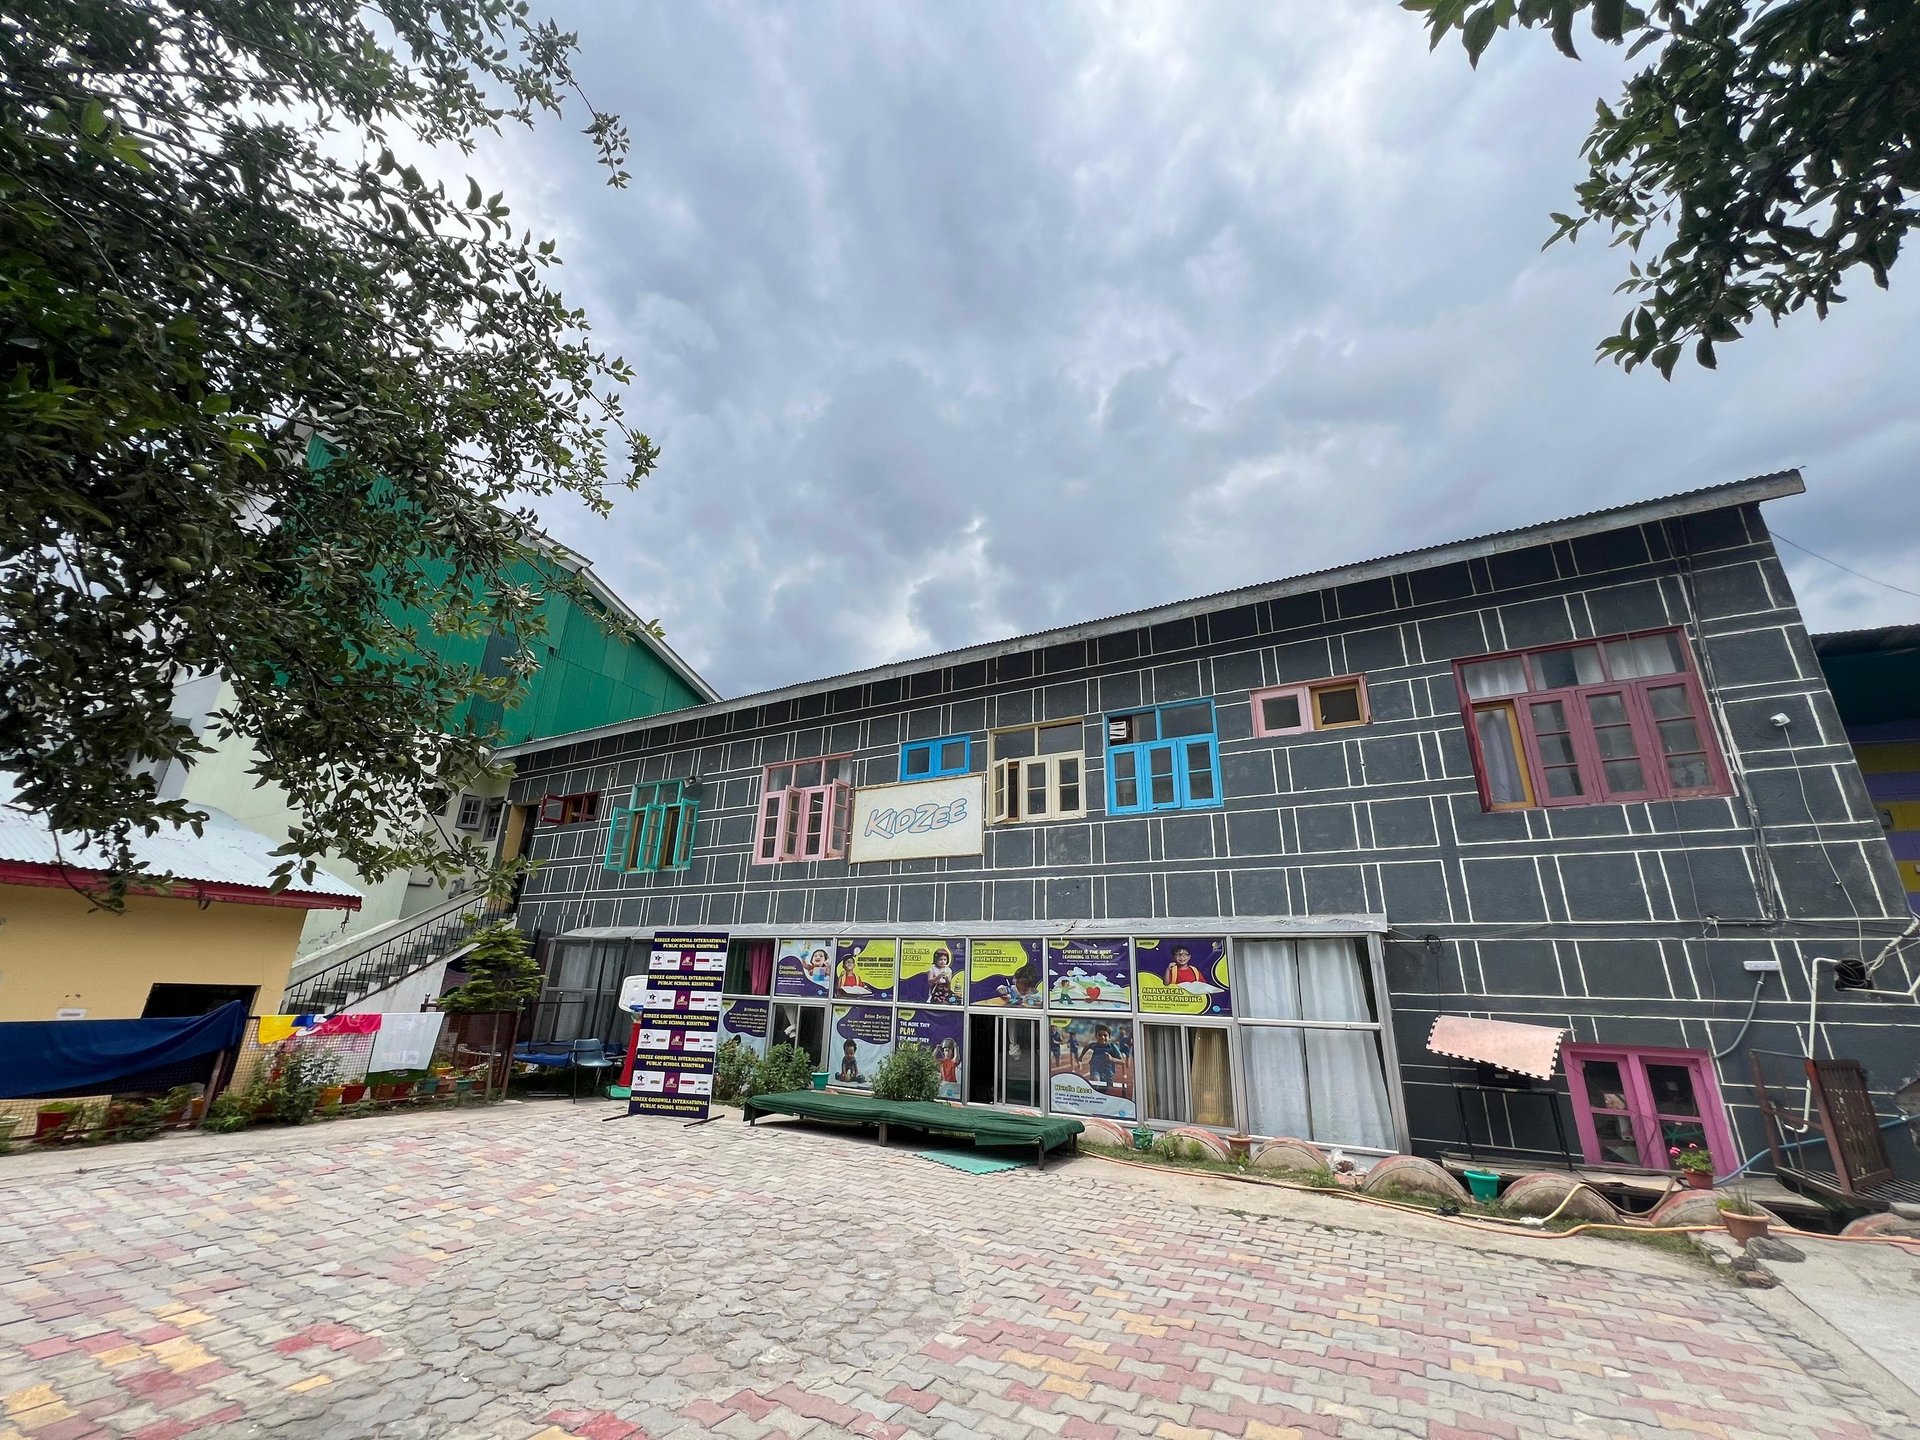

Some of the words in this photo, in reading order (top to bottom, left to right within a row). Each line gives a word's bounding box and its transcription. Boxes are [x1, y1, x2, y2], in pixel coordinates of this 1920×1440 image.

[865, 798, 967, 839] KIDZEE
[1142, 987, 1184, 995] ANALYTICAL
[1142, 994, 1203, 1003] UNDERSTANDING
